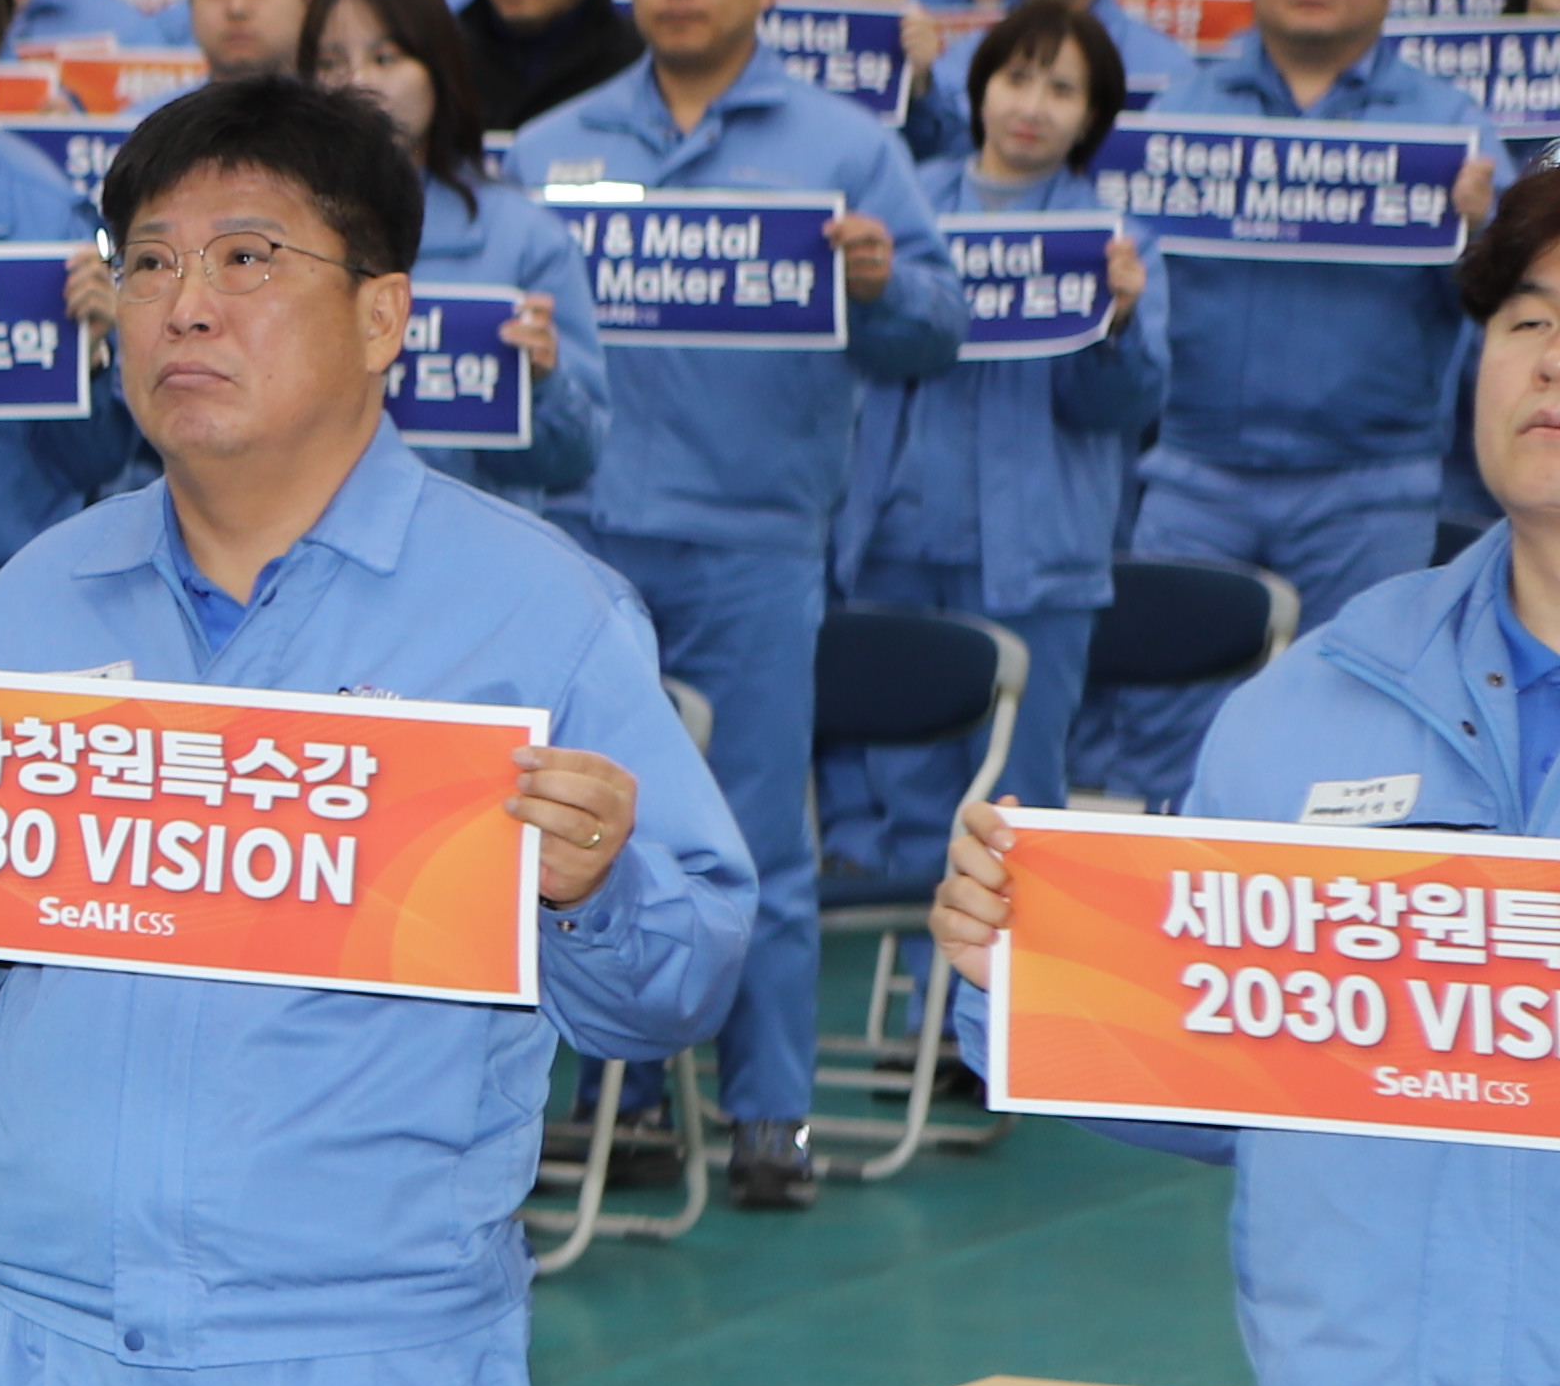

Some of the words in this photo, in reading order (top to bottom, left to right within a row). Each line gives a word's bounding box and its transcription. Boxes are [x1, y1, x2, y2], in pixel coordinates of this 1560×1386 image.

[1145, 133, 1243, 178] Steel
[1251, 138, 1278, 180] &
[1287, 140, 1399, 184] Metal
[1245, 179, 1366, 224] Maker
[604, 212, 634, 260] &
[642, 214, 761, 260] Metal
[597, 260, 726, 305] Maker
[734, 260, 815, 308] 도약
[415, 353, 499, 403] 도약
[79, 812, 356, 905] VISION
[39, 896, 129, 932] SeAH
[134, 911, 175, 936] CSS
[1162, 869, 1560, 970] 세아창원특
[1180, 961, 1388, 1047] 2030
[1405, 979, 1560, 1060] VIS
[1373, 1065, 1479, 1102] SeAH
[1484, 1079, 1530, 1106] CSS
